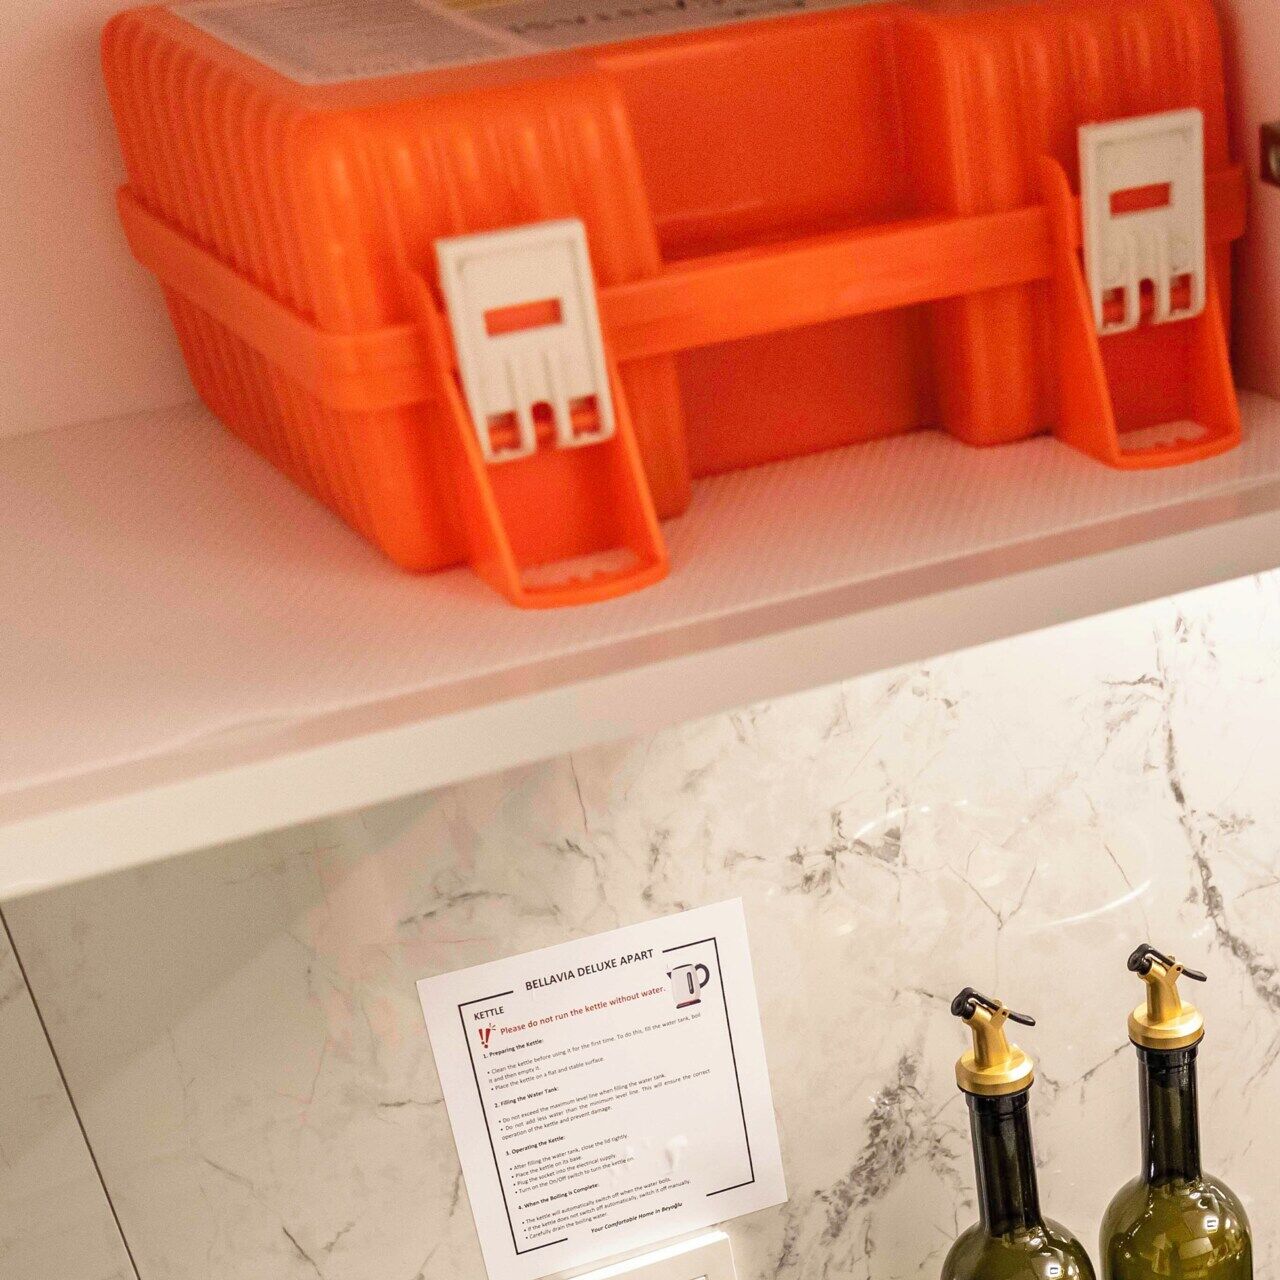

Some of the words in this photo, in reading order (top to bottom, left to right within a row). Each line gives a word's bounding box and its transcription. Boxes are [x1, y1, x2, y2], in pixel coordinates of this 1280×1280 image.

[525, 970, 575, 991] BELLAVIA
[577, 958, 617, 977] DELUXE
[620, 948, 654, 965] APART
[473, 1006, 504, 1021] KETTLE
[500, 1024, 526, 1035] Please
[527, 1020, 538, 1028] do
[539, 1016, 554, 1024] not
[554, 1012, 569, 1021] run
[570, 1008, 584, 1016] the
[584, 1001, 608, 1012] kettle
[608, 992, 640, 1006] without
